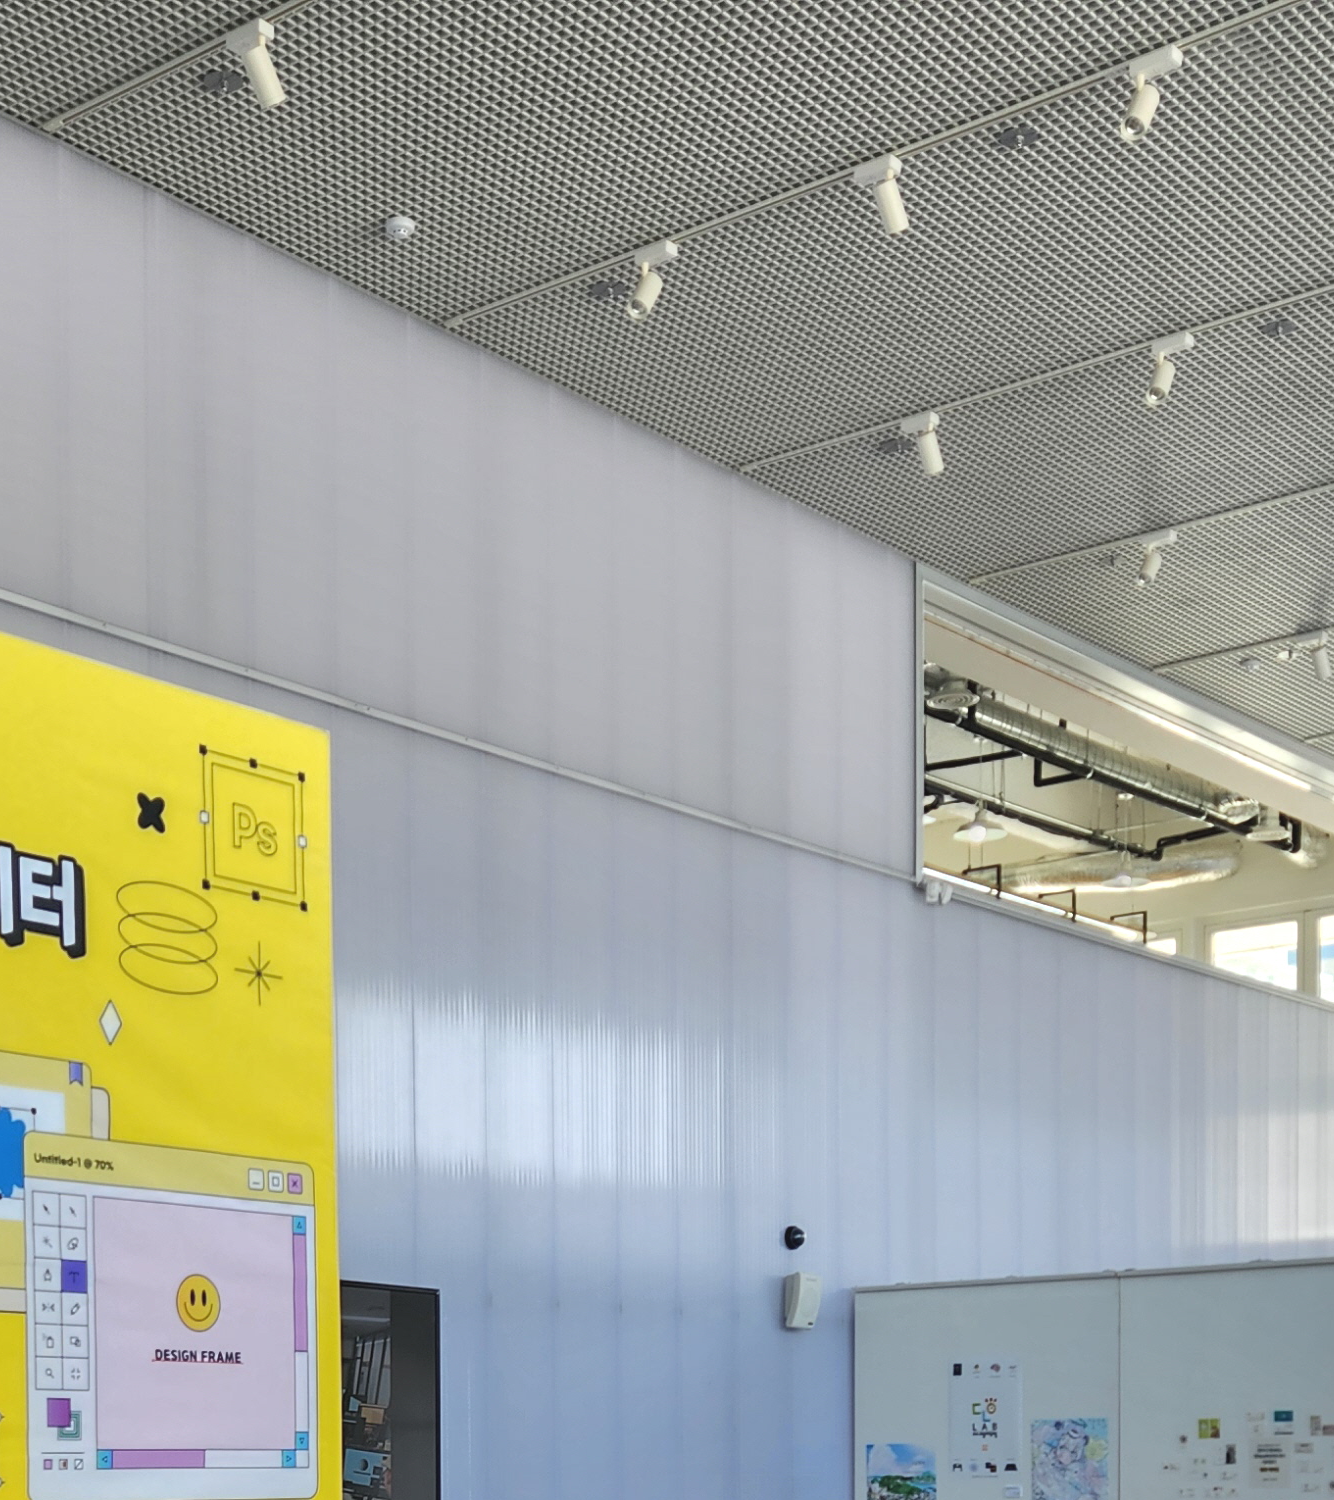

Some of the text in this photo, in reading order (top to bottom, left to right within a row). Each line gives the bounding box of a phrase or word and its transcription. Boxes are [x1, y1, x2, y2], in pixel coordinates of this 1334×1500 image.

[232, 802, 278, 856] Ps
[33, 1152, 82, 1167] Untitled-1
[94, 1160, 114, 1171] 70%
[154, 1348, 242, 1364] DESIGN FRAME
